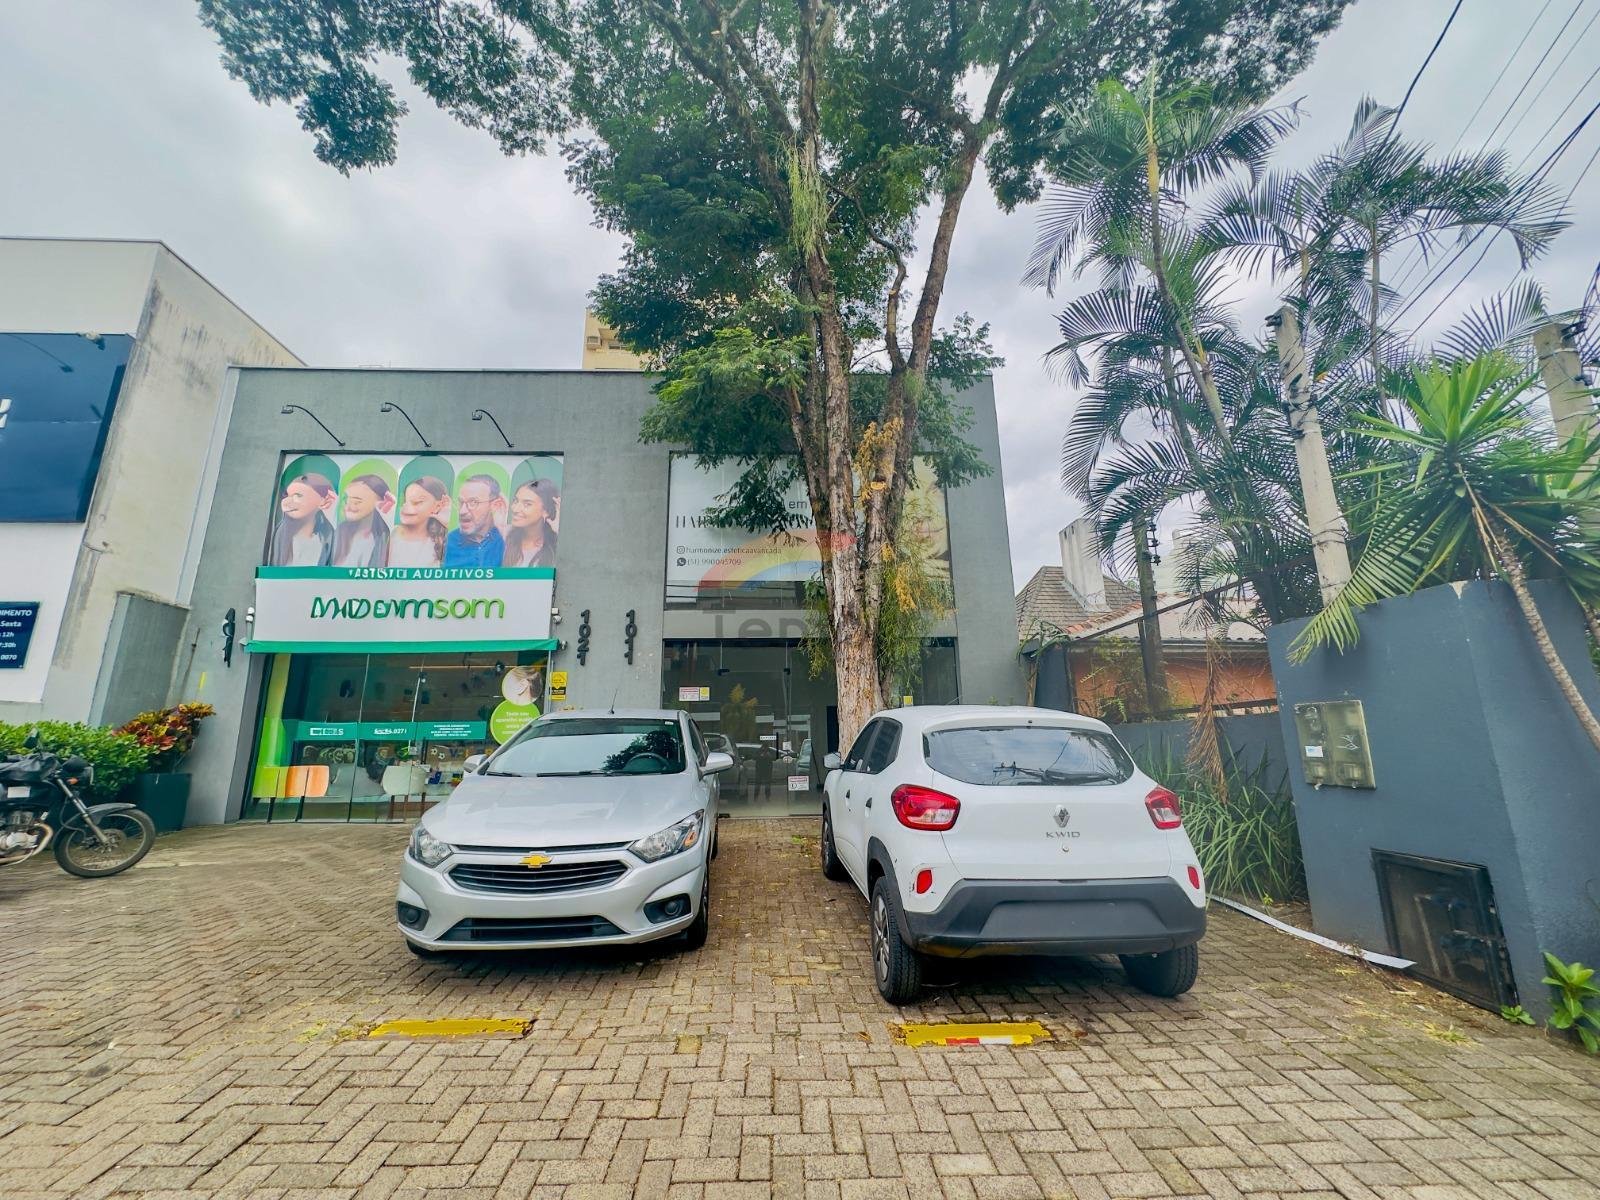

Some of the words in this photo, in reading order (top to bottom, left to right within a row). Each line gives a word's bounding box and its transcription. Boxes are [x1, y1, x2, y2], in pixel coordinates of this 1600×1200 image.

[412, 568, 495, 579] AUDITIVOS
[576, 609, 592, 666] 1021
[624, 609, 638, 665] 1011
[1046, 831, 1081, 839] KWID
